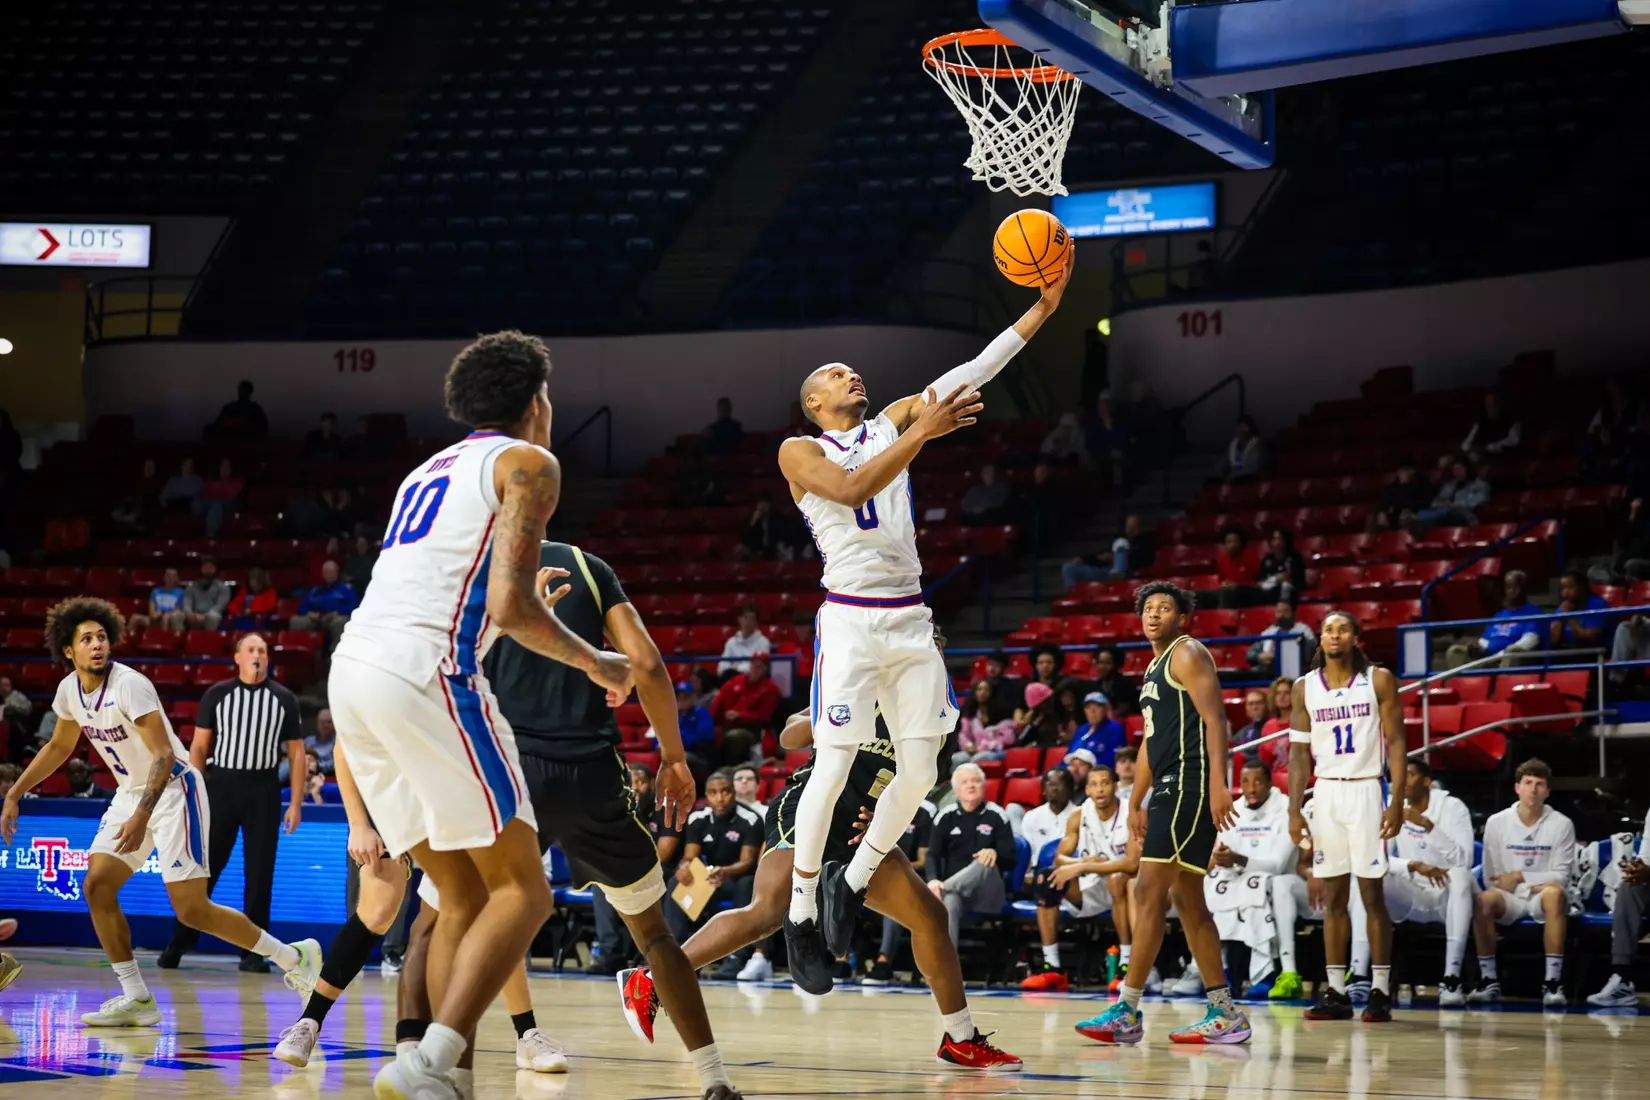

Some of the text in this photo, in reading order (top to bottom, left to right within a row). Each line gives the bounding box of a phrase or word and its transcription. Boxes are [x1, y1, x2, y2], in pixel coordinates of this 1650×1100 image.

[68, 229, 123, 248] LOTS
[1176, 310, 1223, 337] 101
[333, 348, 376, 372] 119
[380, 475, 451, 551] 10
[1351, 702, 1371, 718] TECH
[104, 724, 129, 743] TECH
[1332, 723, 1356, 755] 11
[104, 746, 129, 776] 3
[16, 848, 41, 869] LA
